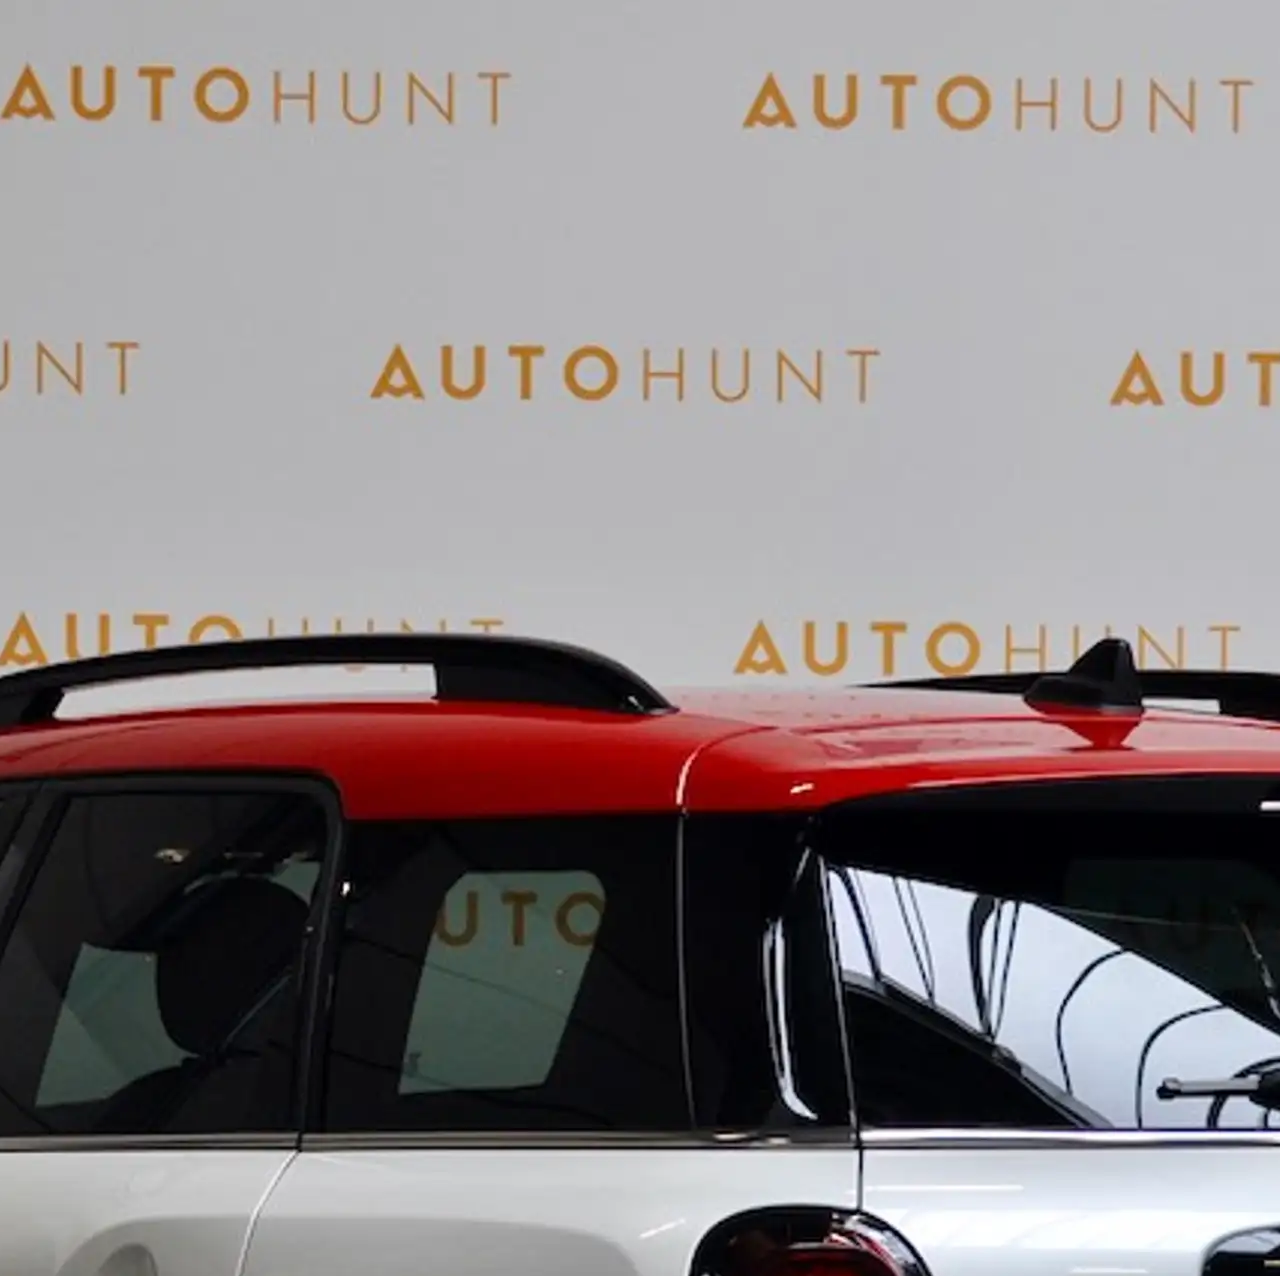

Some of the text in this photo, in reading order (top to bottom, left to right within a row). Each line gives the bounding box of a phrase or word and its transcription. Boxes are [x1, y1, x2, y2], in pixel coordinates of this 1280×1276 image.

[0, 64, 509, 126] AUTOHUNT
[744, 72, 1252, 132] AUTOHUNT
[370, 343, 879, 402] AUTOHUNT
